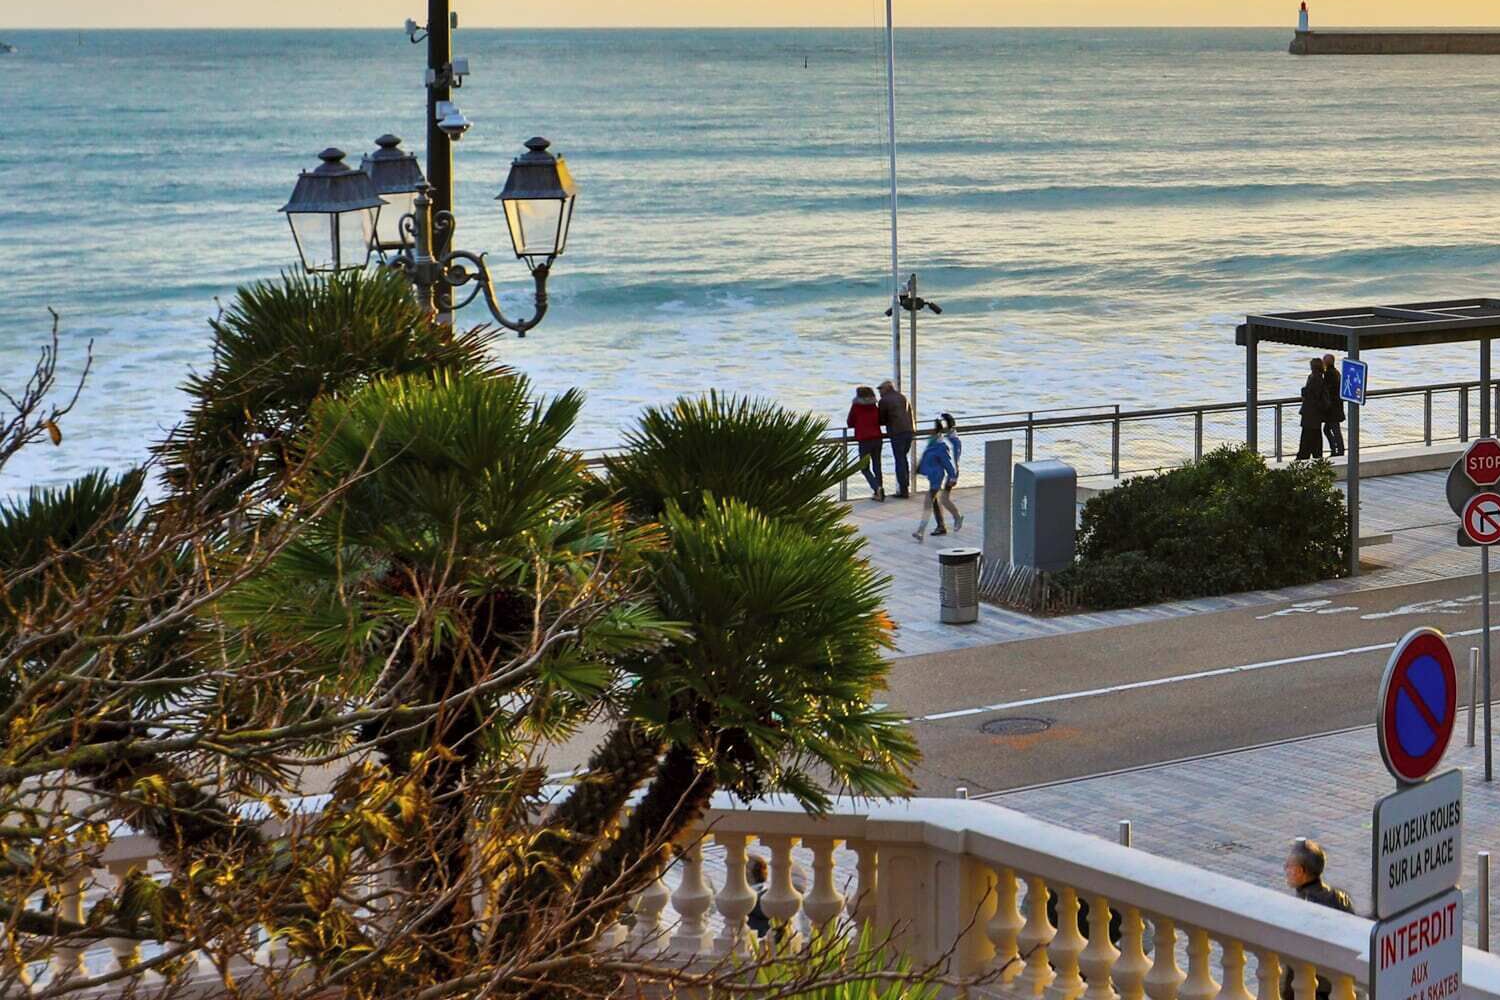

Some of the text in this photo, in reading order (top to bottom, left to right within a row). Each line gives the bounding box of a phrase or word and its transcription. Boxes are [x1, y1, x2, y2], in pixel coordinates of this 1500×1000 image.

[1382, 800, 1460, 857] AUX DEUX ROUES
[1388, 838, 1454, 889] SUR LA PLACE
[1380, 903, 1457, 971] INTERDIT
[1410, 960, 1429, 988] AUX
[1427, 971, 1459, 1000] SKATES
